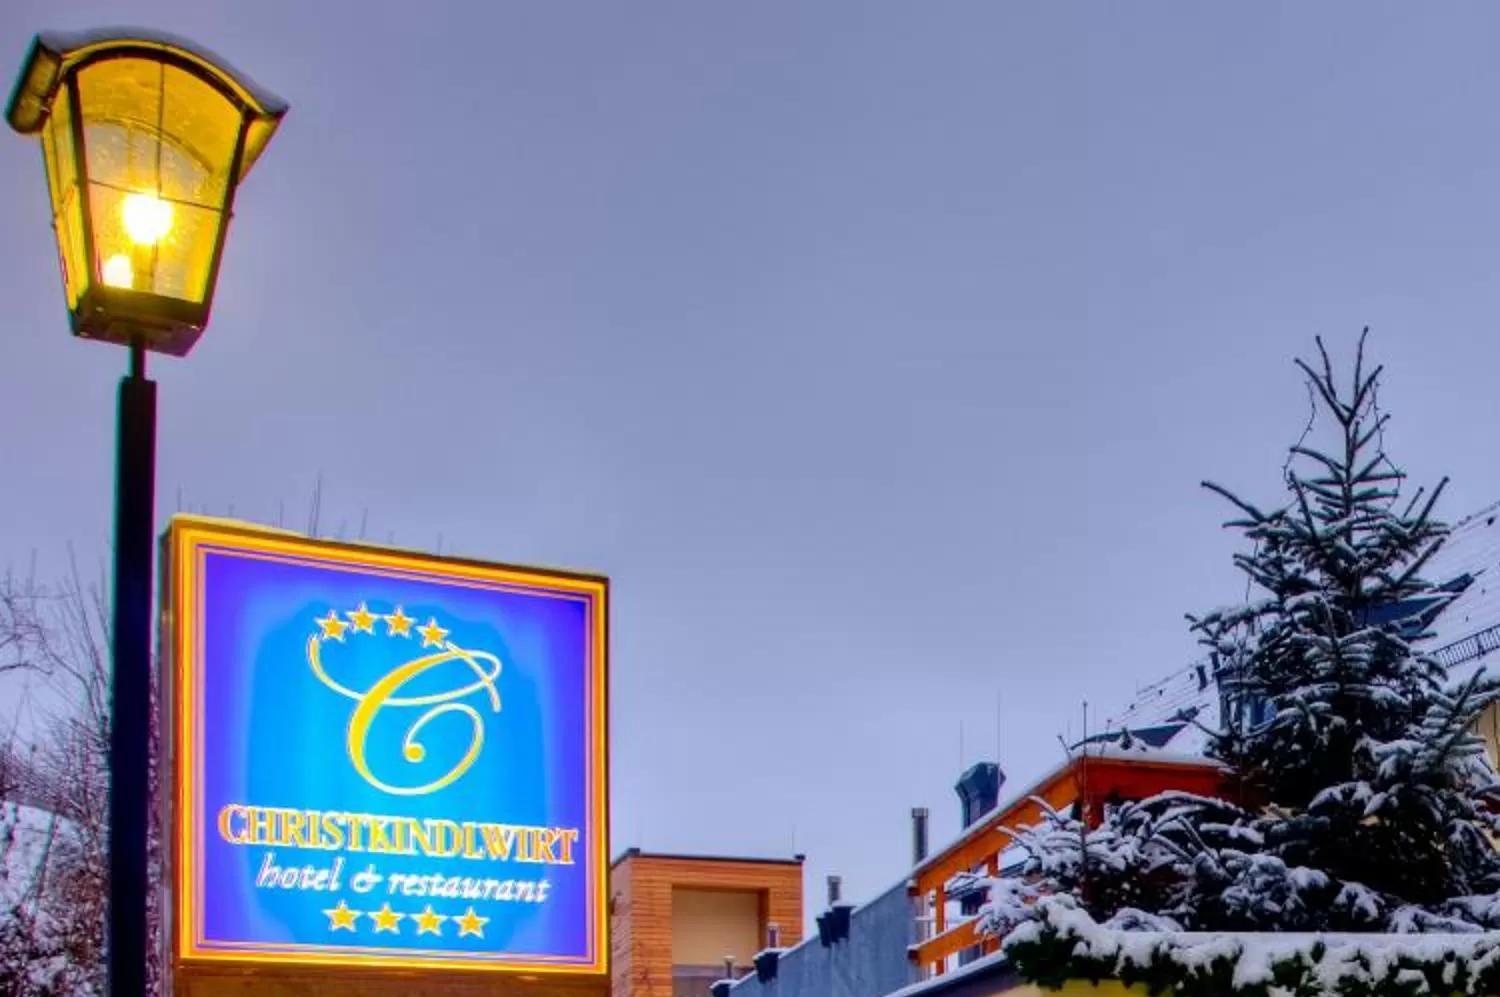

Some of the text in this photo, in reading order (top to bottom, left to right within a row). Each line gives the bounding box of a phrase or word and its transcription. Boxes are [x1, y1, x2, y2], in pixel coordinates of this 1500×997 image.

[218, 804, 579, 864] CHRISTKINDLWIRT
[255, 851, 551, 902] hotel & restaurant
